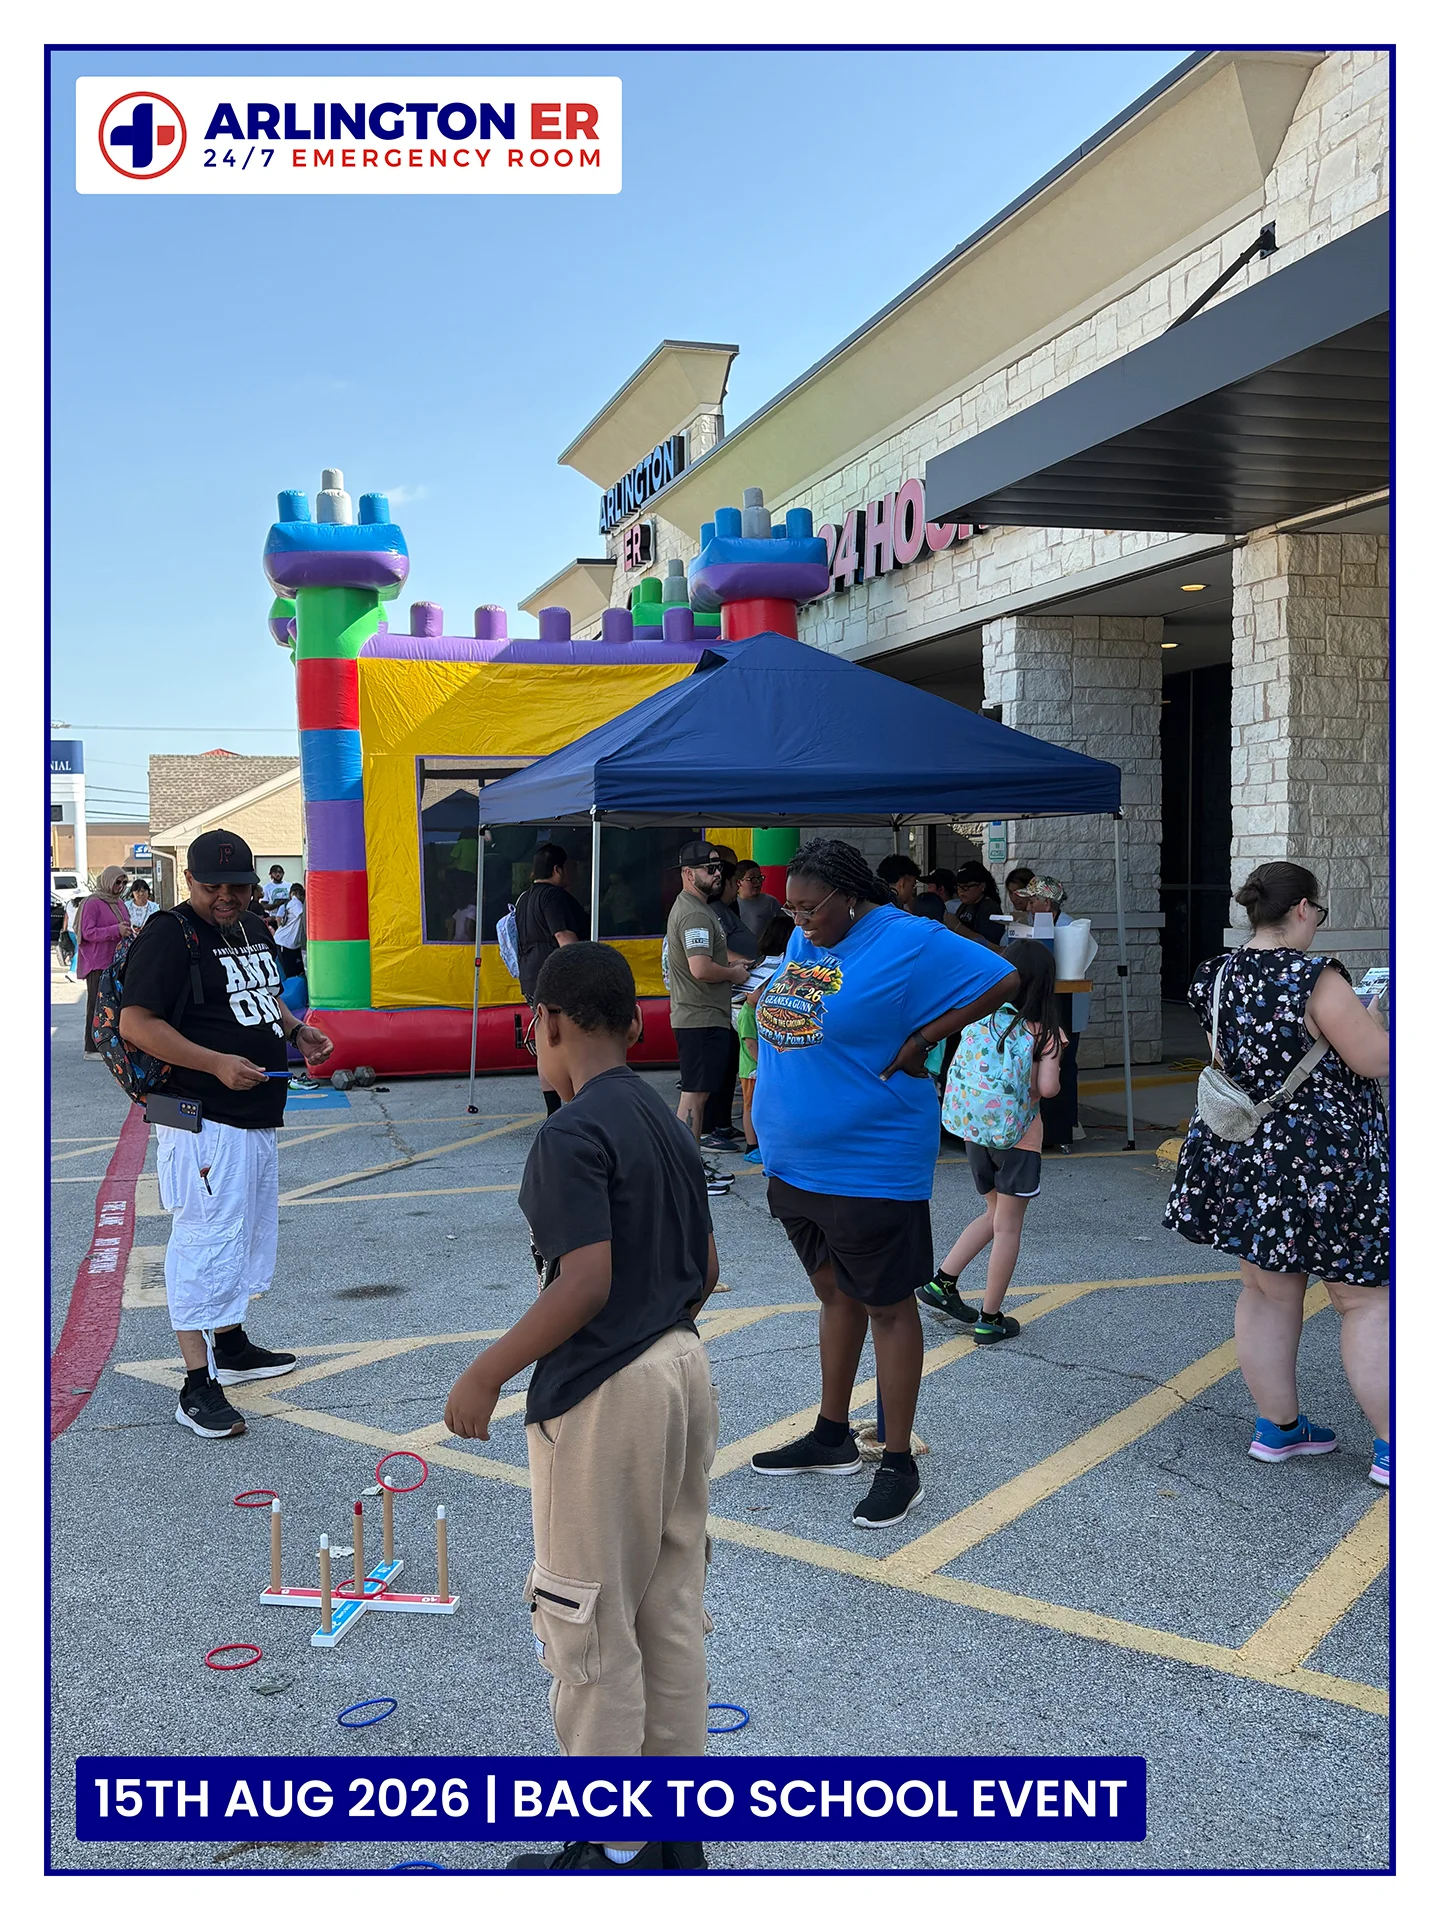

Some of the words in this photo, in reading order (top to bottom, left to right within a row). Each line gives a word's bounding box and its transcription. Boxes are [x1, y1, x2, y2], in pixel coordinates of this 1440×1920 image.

[600, 435, 678, 531] ARLINGTON
[624, 523, 643, 572] ER
[219, 951, 280, 993] AND
[804, 987, 824, 1003] 26
